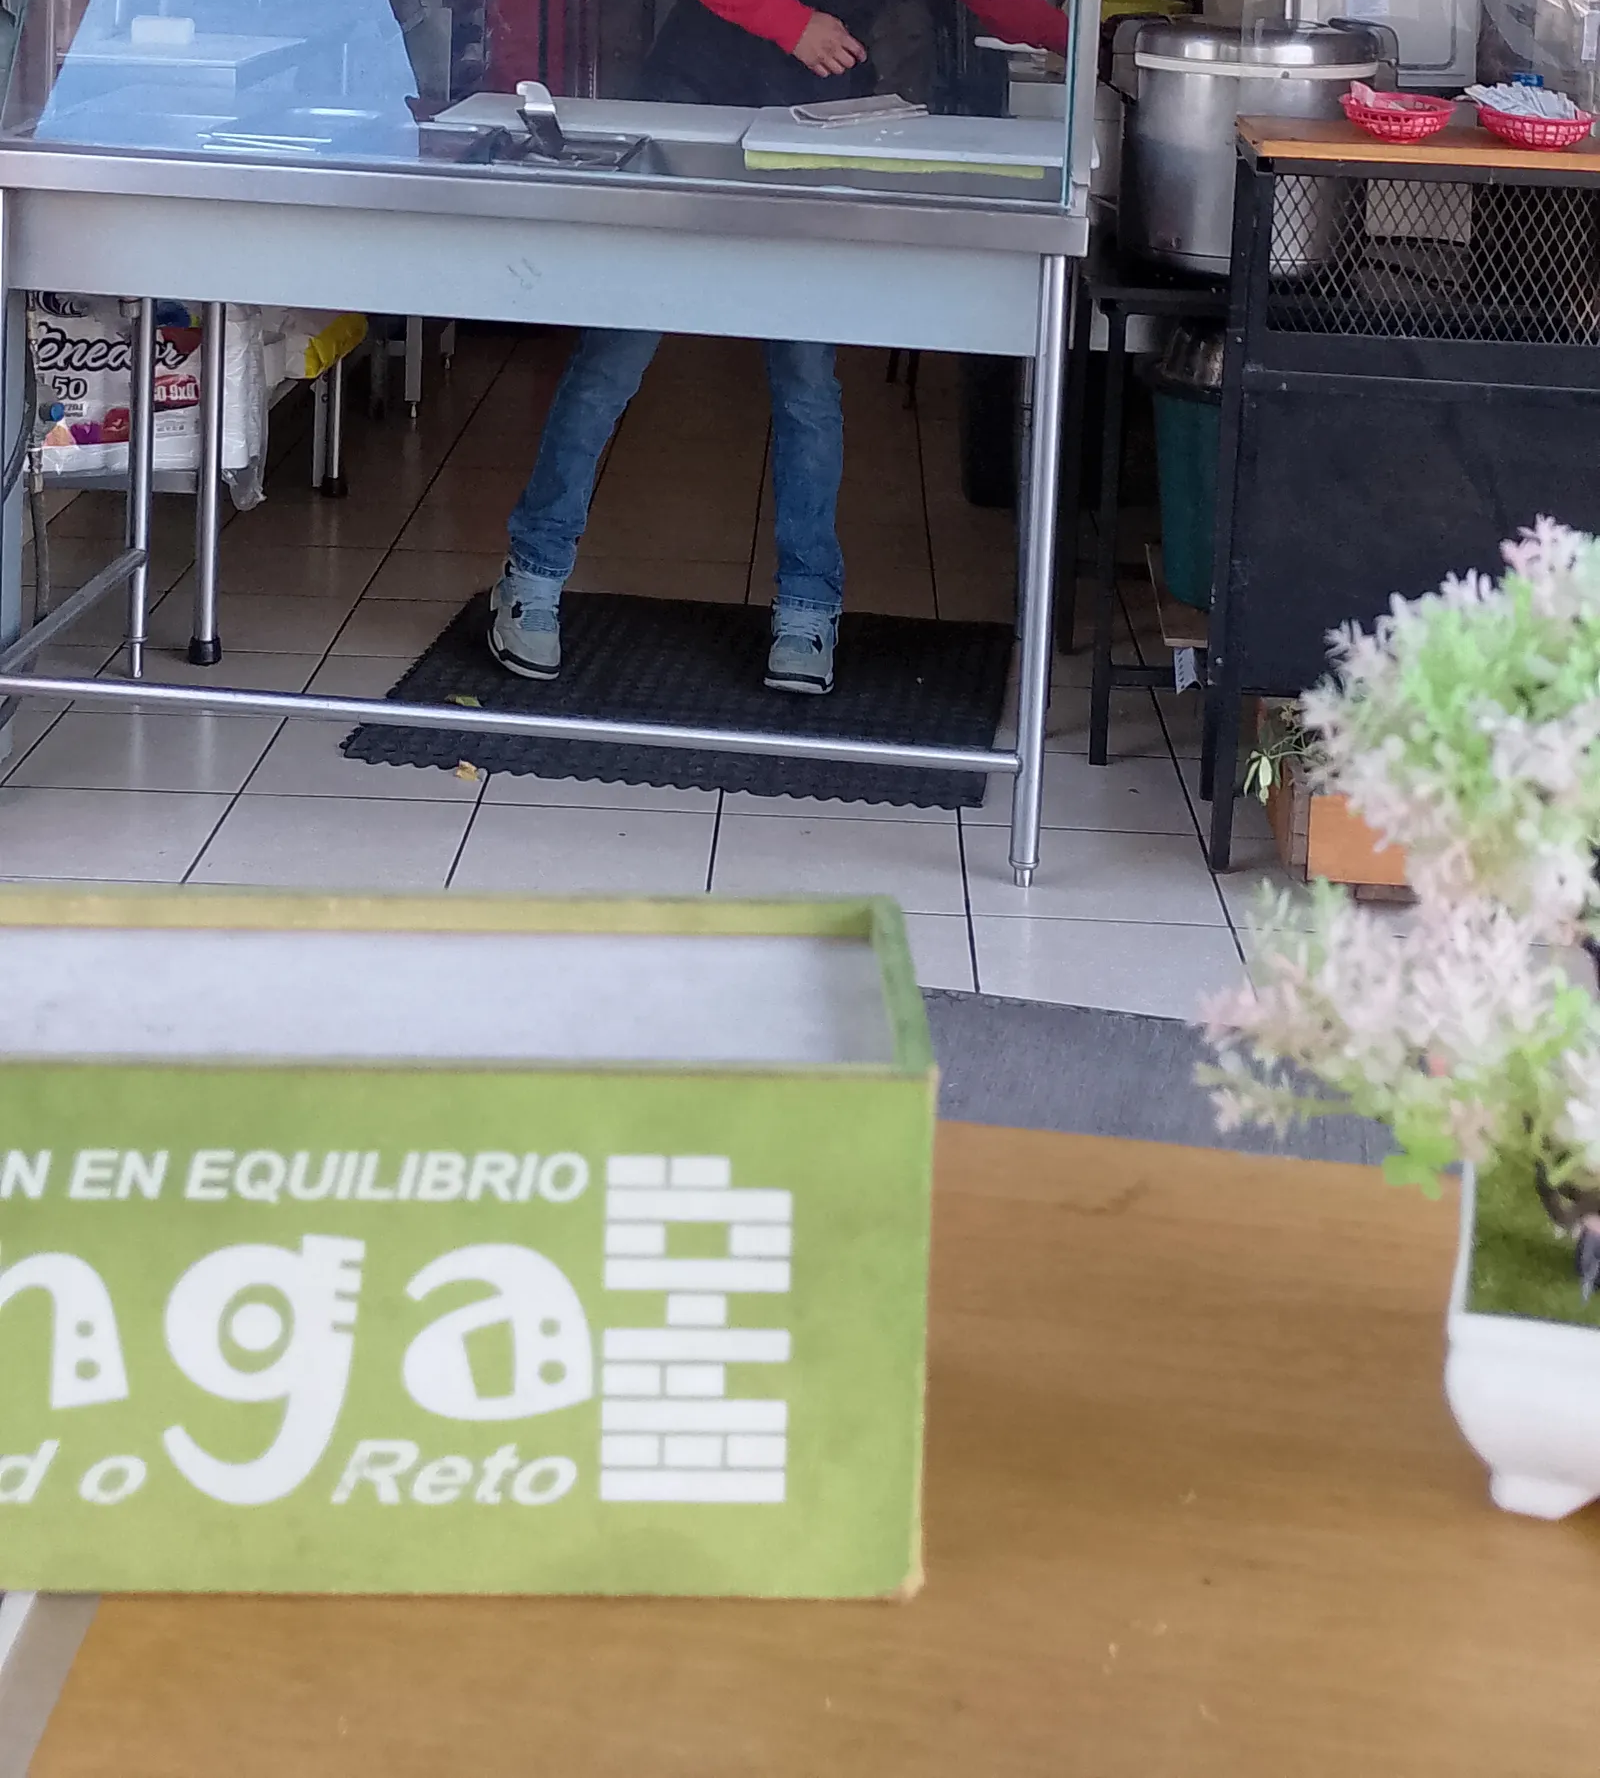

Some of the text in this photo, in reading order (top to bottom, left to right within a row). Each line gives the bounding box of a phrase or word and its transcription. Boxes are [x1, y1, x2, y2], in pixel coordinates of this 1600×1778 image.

[52, 375, 88, 400] 50
[69, 1149, 168, 1200] EN
[184, 1149, 590, 1204] EQUILIBRIO
[330, 1438, 578, 1506] Reto
